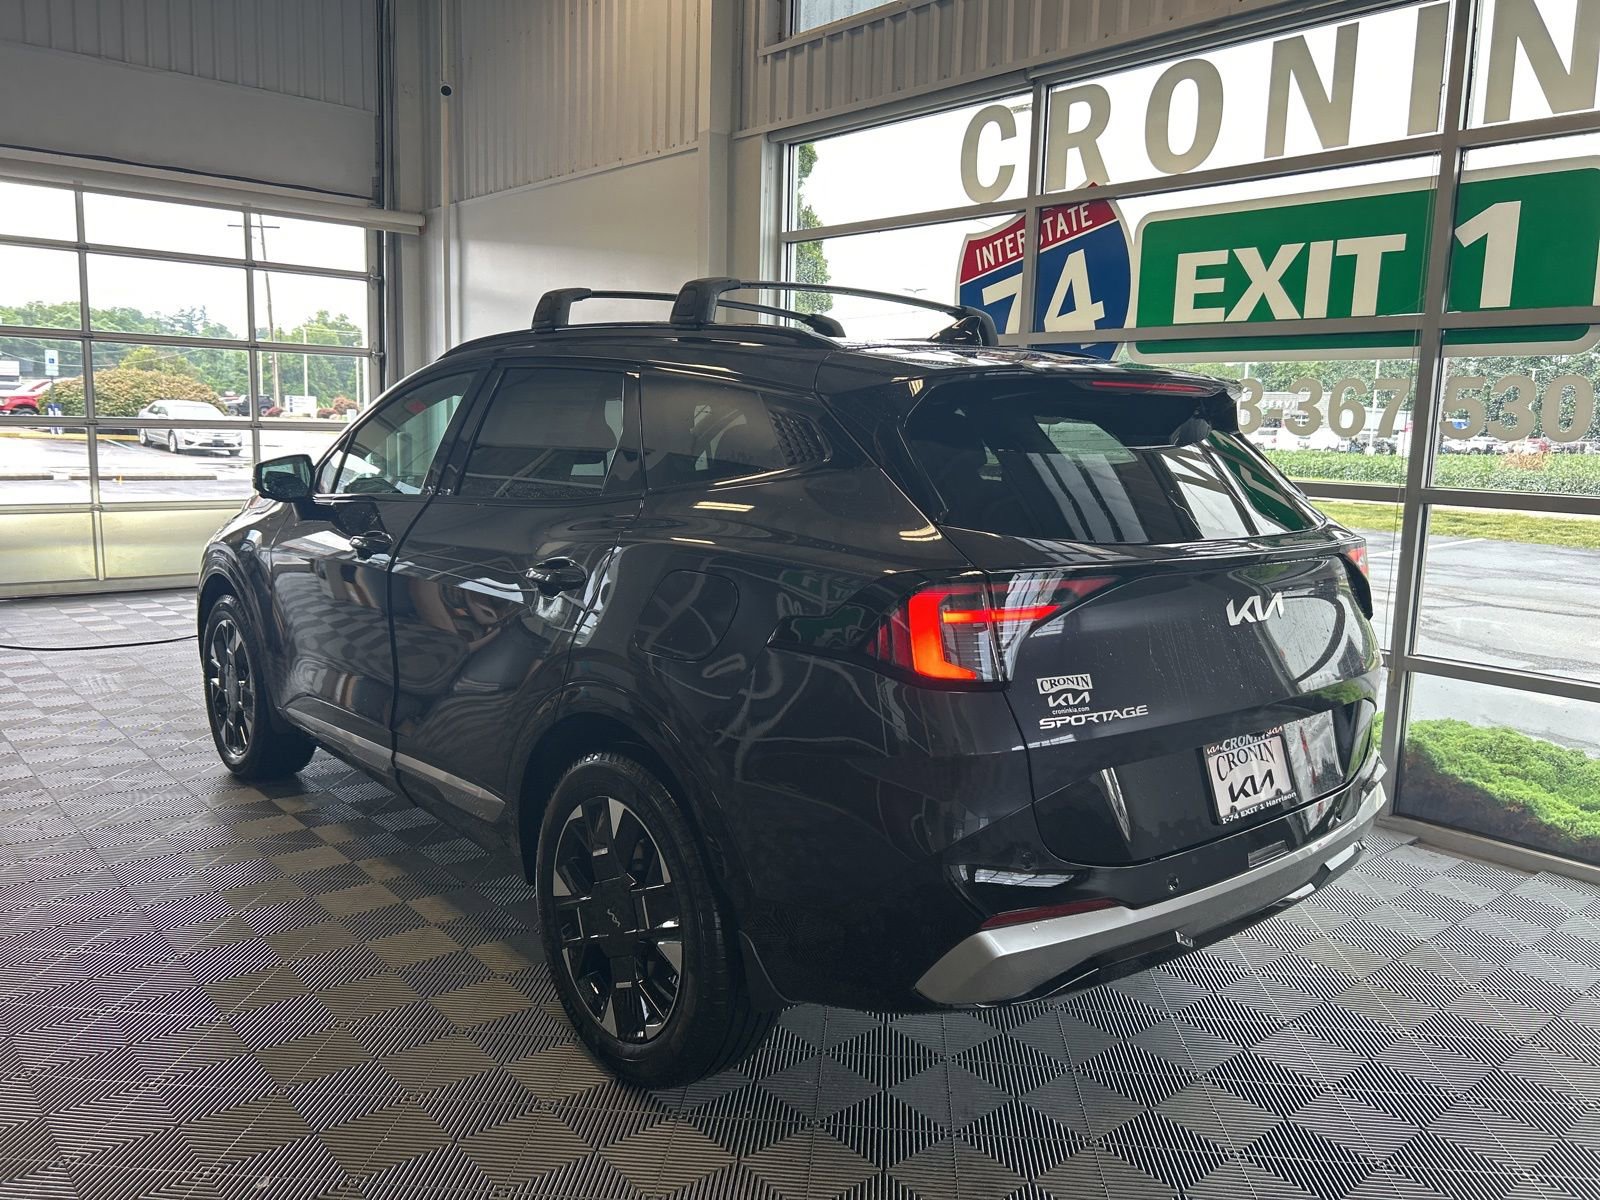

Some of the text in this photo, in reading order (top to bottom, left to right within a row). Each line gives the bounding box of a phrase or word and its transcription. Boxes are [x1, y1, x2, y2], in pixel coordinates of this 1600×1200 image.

[960, 0, 1600, 204] CRONIN
[975, 202, 1093, 272] INTERTATE
[1173, 233, 1407, 324] EXIT
[1454, 200, 1521, 308] 1
[981, 248, 1105, 349] 74
[1226, 591, 1284, 626] KIA
[1040, 675, 1090, 693] CRONIN
[1048, 692, 1090, 707] KIA
[1039, 704, 1149, 730] SPORTAGE
[1052, 706, 1090, 715] croninkia.com
[1216, 740, 1276, 781] CRONIN
[1228, 768, 1275, 803] KIA
[1221, 813, 1239, 825] I-74
[1240, 806, 1258, 818] EXIT
[1266, 791, 1297, 808] Harrison
